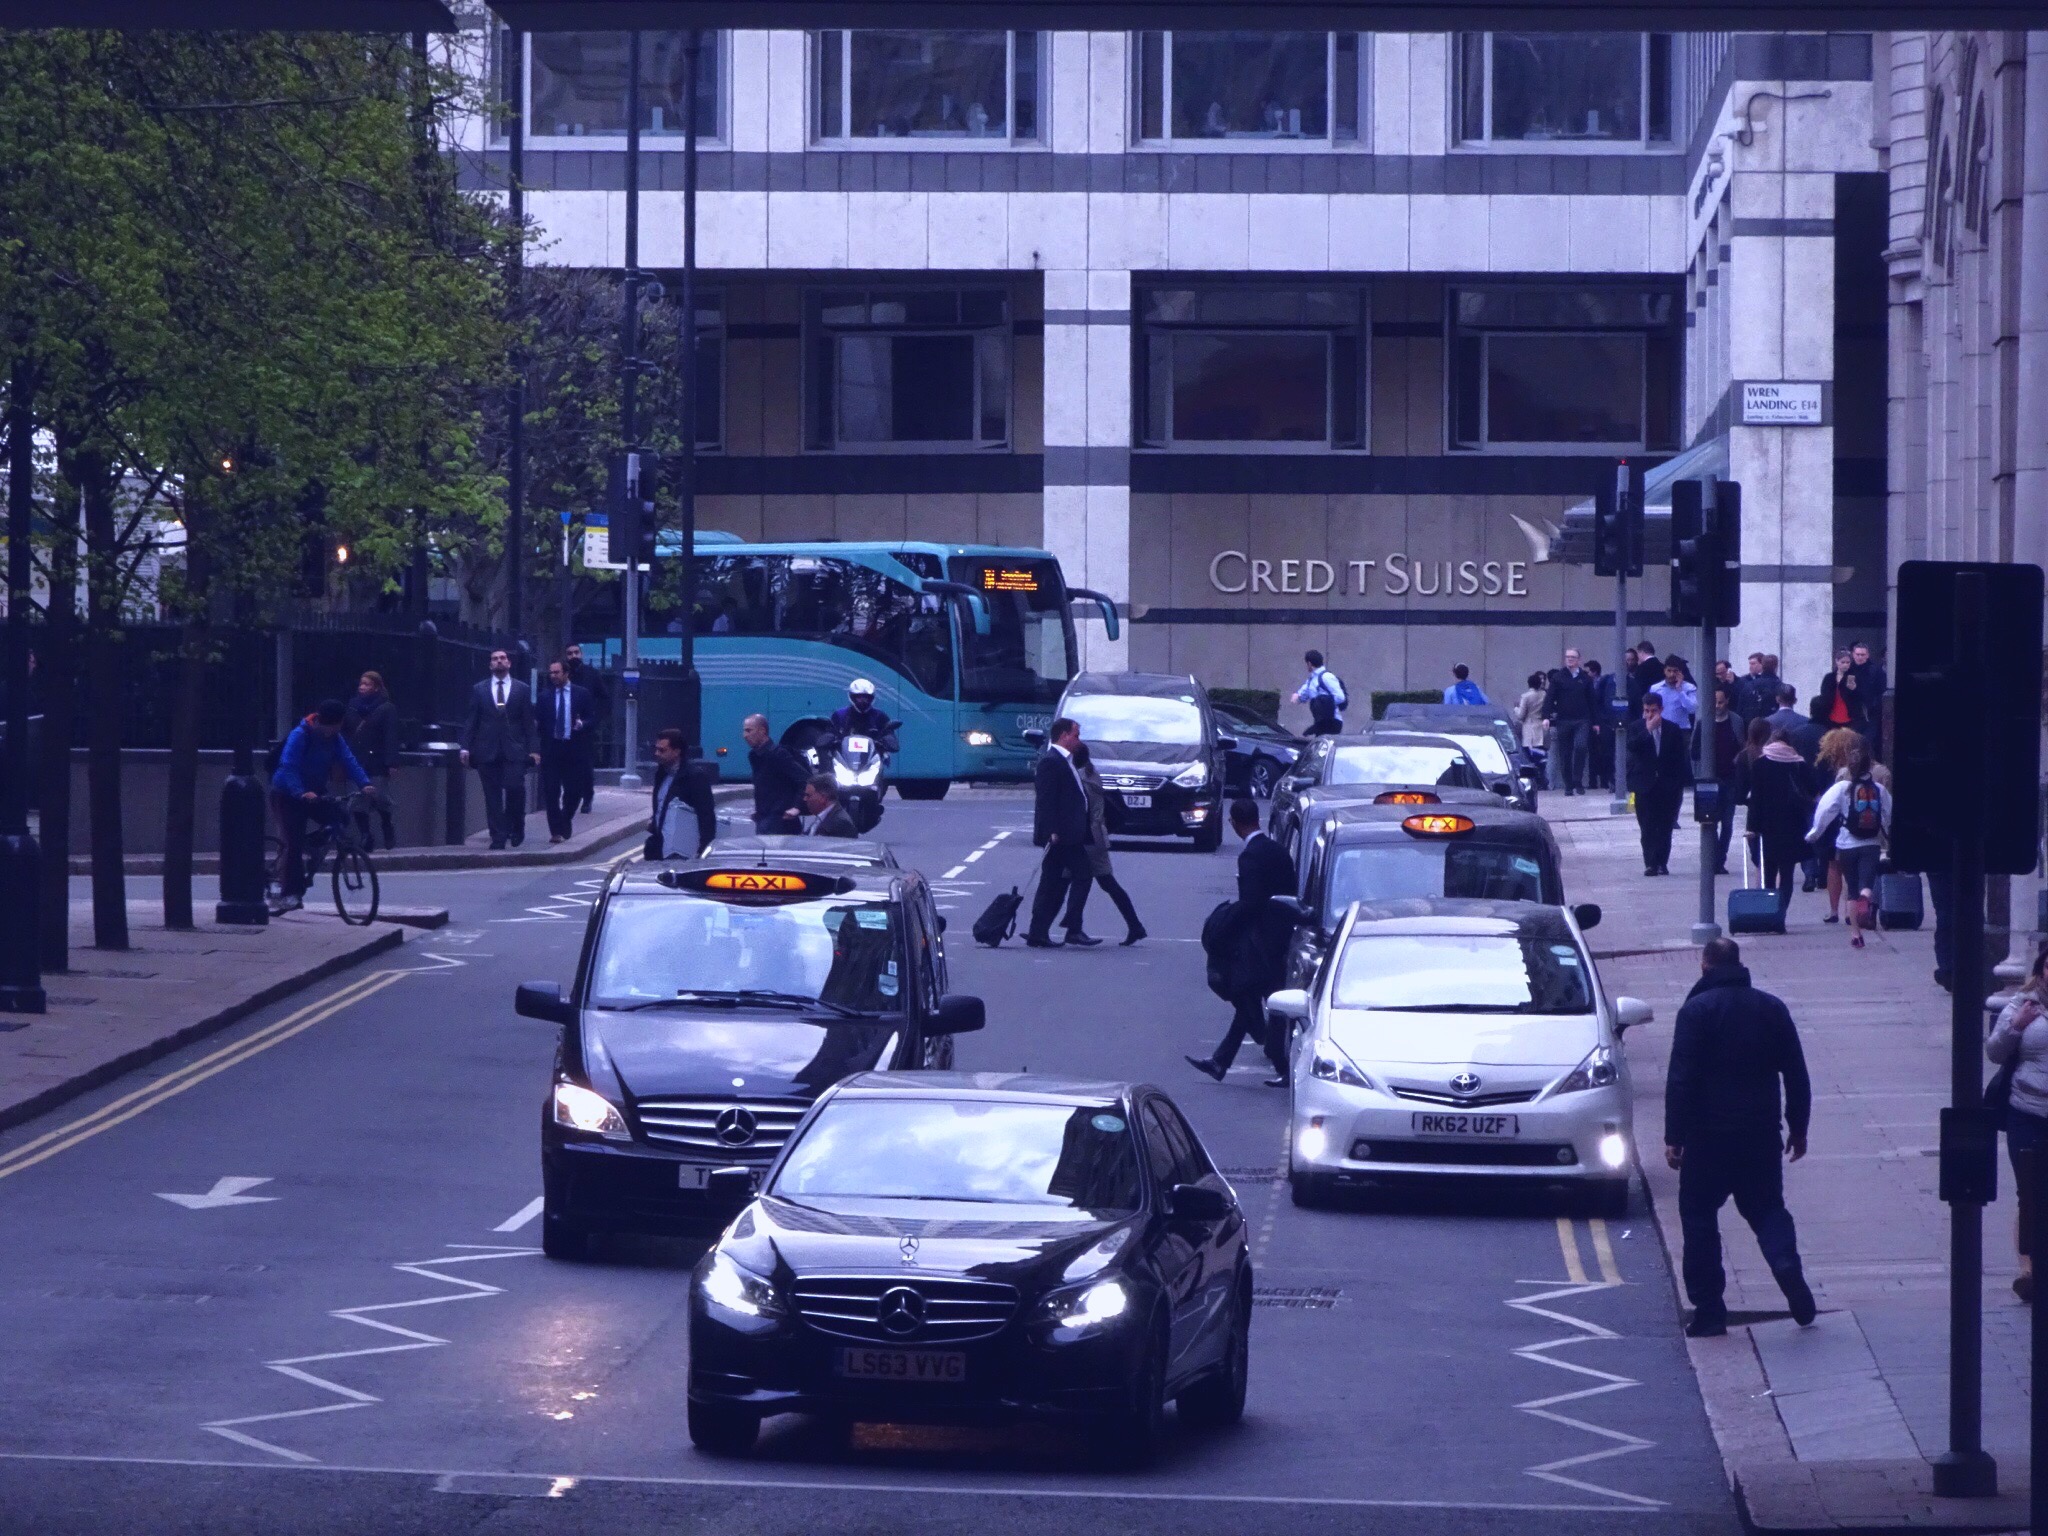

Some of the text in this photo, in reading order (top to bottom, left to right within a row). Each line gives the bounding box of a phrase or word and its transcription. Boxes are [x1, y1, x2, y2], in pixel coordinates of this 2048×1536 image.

[1747, 387, 1779, 397] WREN
[1747, 400, 1818, 411] LANDING E14
[1209, 549, 1528, 596] CREDIT SUISSE
[1423, 818, 1460, 832] TAXI
[726, 875, 787, 890] TAXI
[1421, 1115, 1507, 1134] RK62 UZF
[847, 1352, 961, 1378] LS63 VVG
